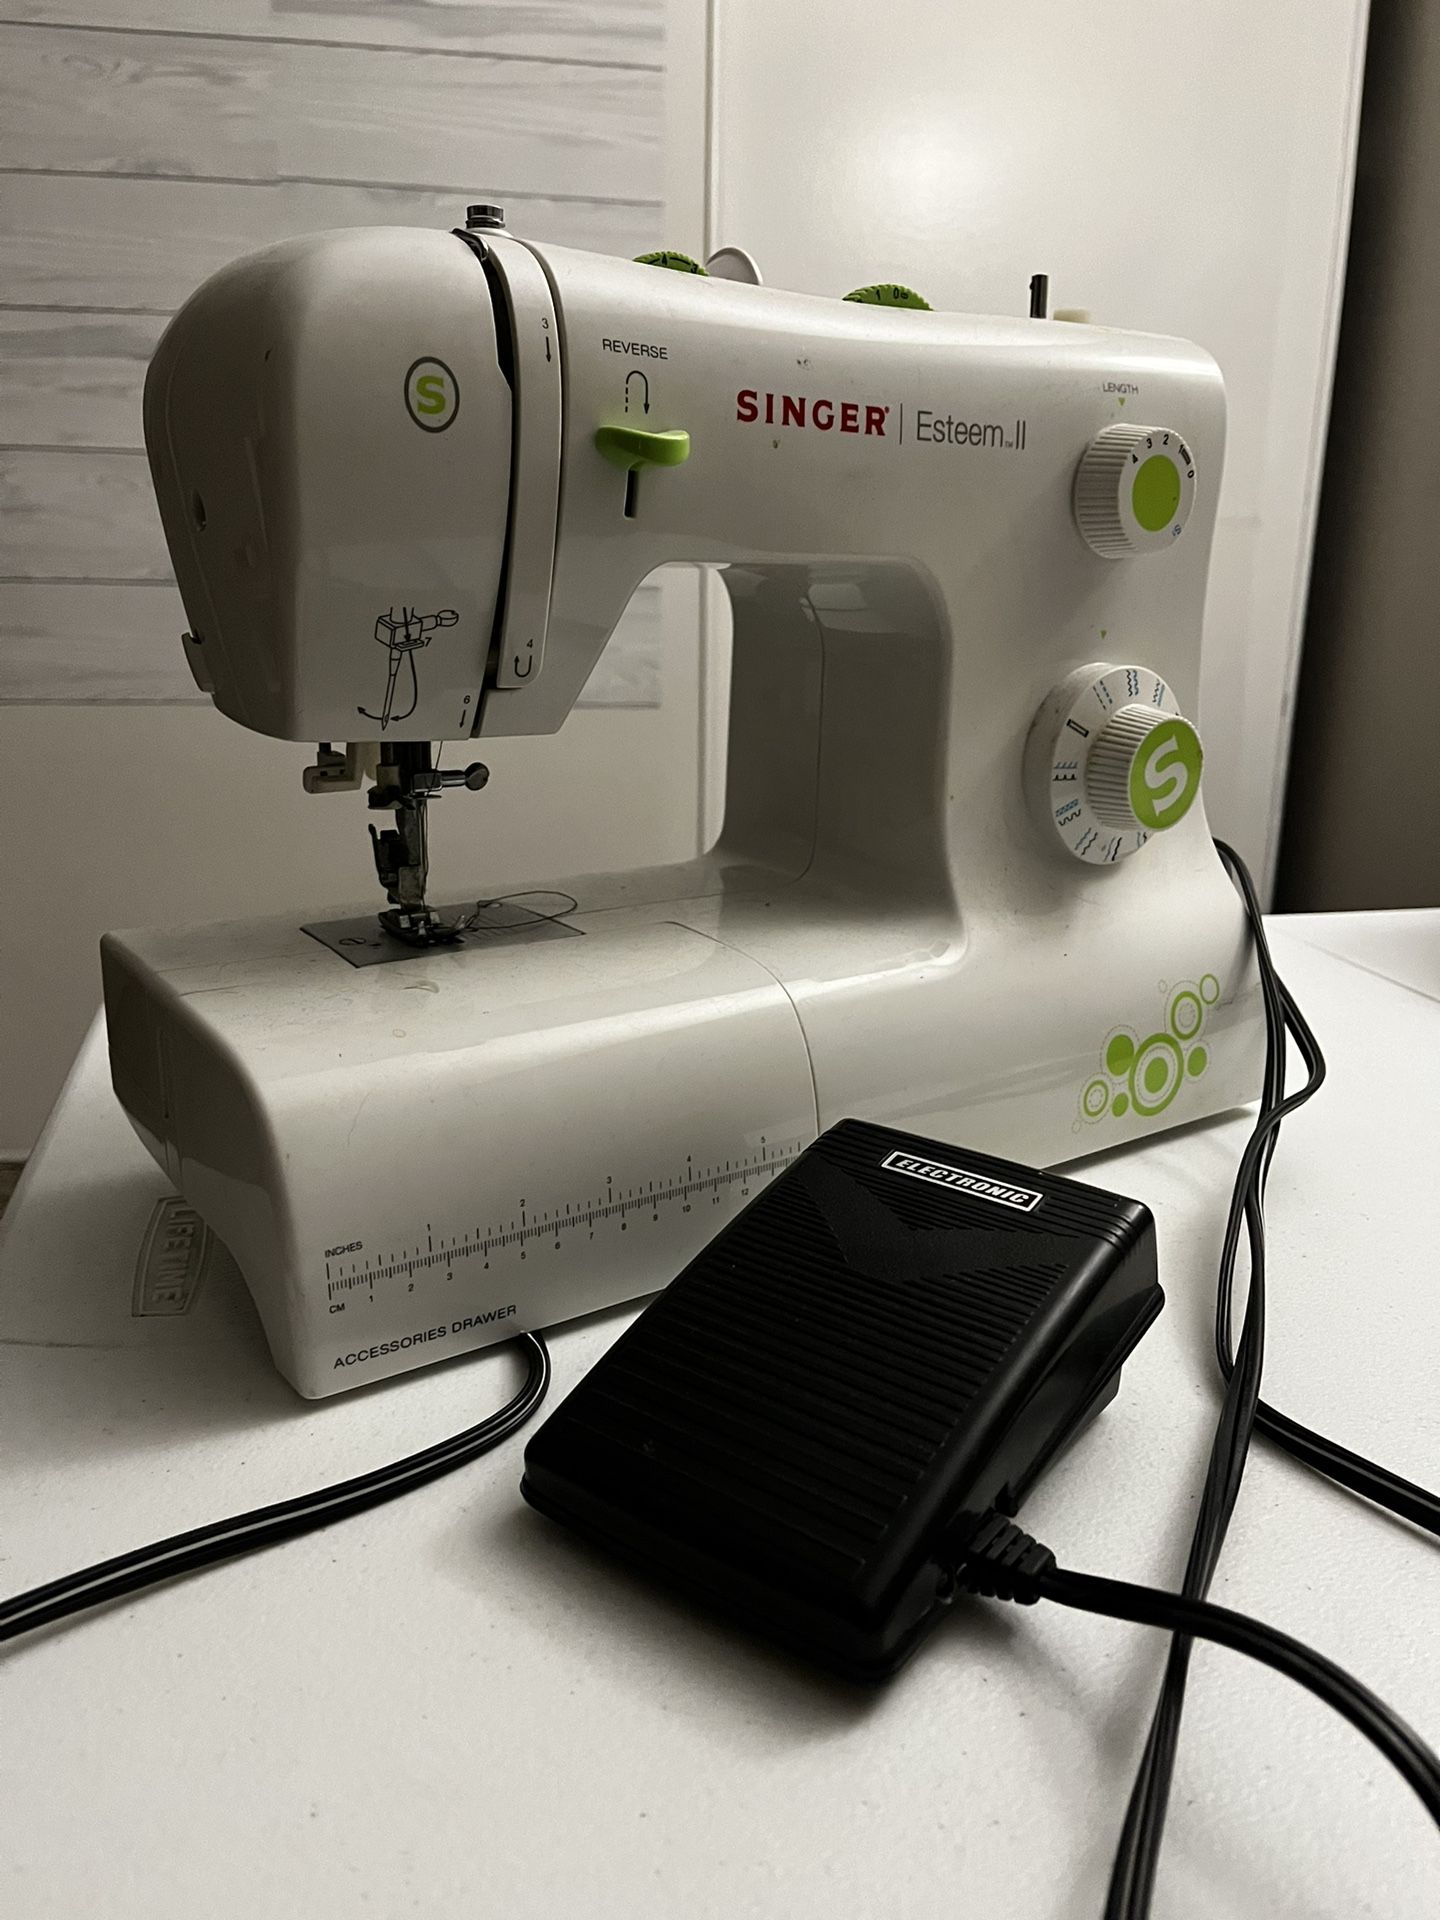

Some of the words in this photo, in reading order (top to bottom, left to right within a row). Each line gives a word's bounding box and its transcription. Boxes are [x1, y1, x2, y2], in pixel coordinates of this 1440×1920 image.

[541, 317, 549, 329] 3
[602, 338, 668, 360] REVERSE
[416, 375, 446, 415] S
[1103, 383, 1139, 395] LENGTH
[916, 410, 1004, 447] Esteem
[1146, 438, 1153, 448] 3
[1163, 434, 1169, 445] 2
[1187, 470, 1194, 478] 0
[425, 637, 432, 647] 7
[526, 639, 534, 649] 4
[463, 695, 470, 705] 6
[1145, 734, 1188, 816] S
[426, 1223, 431, 1232] 1
[520, 1199, 525, 1207] 2
[606, 1176, 612, 1184] 3
[686, 1155, 692, 1163] 4
[761, 1136, 766, 1144] 5
[896, 1159, 1030, 1203] ELECTRONIC
[325, 1241, 363, 1259] INCHES
[408, 1284, 414, 1292] 2
[447, 1272, 453, 1281] 3
[484, 1262, 489, 1270] 4
[520, 1251, 526, 1259] 5
[555, 1242, 560, 1250] 6
[589, 1231, 594, 1240] 7
[621, 1222, 627, 1231] 8
[653, 1214, 658, 1222] 9
[682, 1204, 691, 1213] 10
[712, 1197, 720, 1205] 11
[741, 1188, 749, 1196] 12
[329, 1303, 346, 1314] CM
[333, 1326, 447, 1369] ACCESSORIES
[452, 1304, 518, 1334] DRAWER
